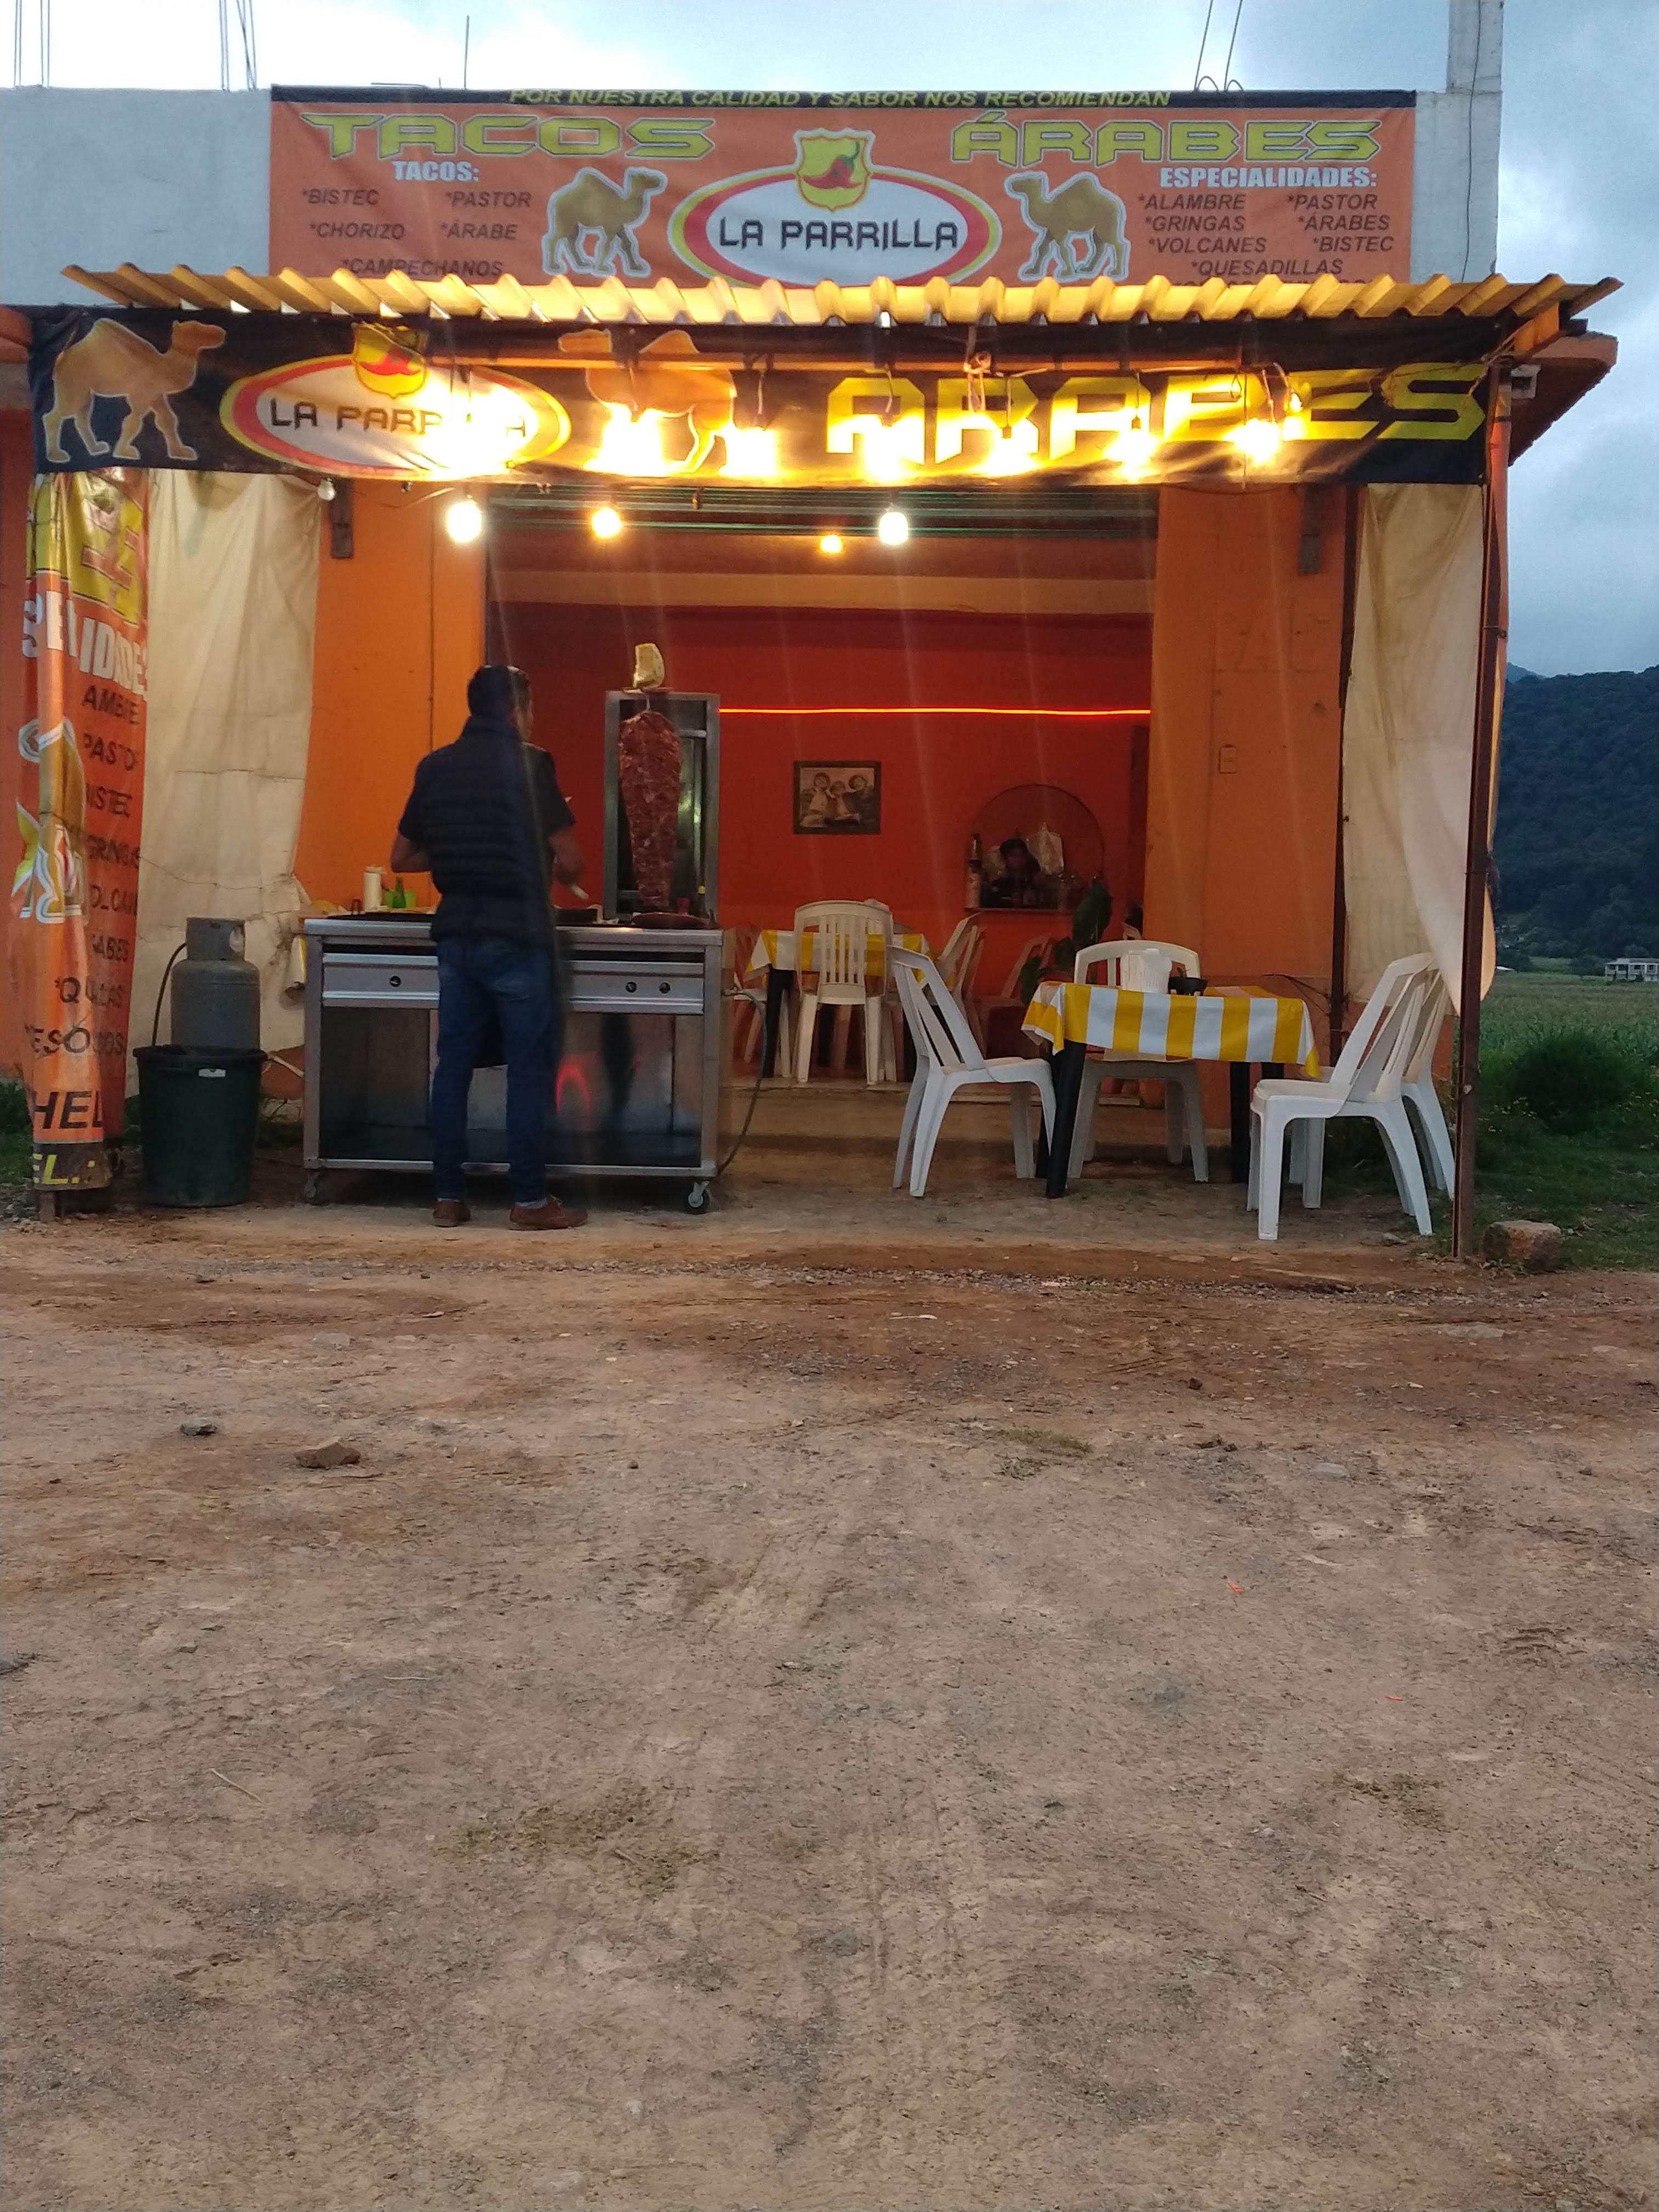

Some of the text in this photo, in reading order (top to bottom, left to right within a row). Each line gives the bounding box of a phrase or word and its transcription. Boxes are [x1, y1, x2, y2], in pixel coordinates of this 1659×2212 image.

[510, 90, 1171, 106] POR NUESTRA CALIDAD Y SABOR NOS RECOMIENDAN
[300, 112, 715, 160] TACOS
[951, 111, 1382, 167] ÁRABES
[392, 160, 479, 182] TACOS:
[1160, 166, 1377, 188] ESPECIALIDADES:
[719, 216, 958, 251] LA PARRILLA
[270, 398, 319, 431] LA
